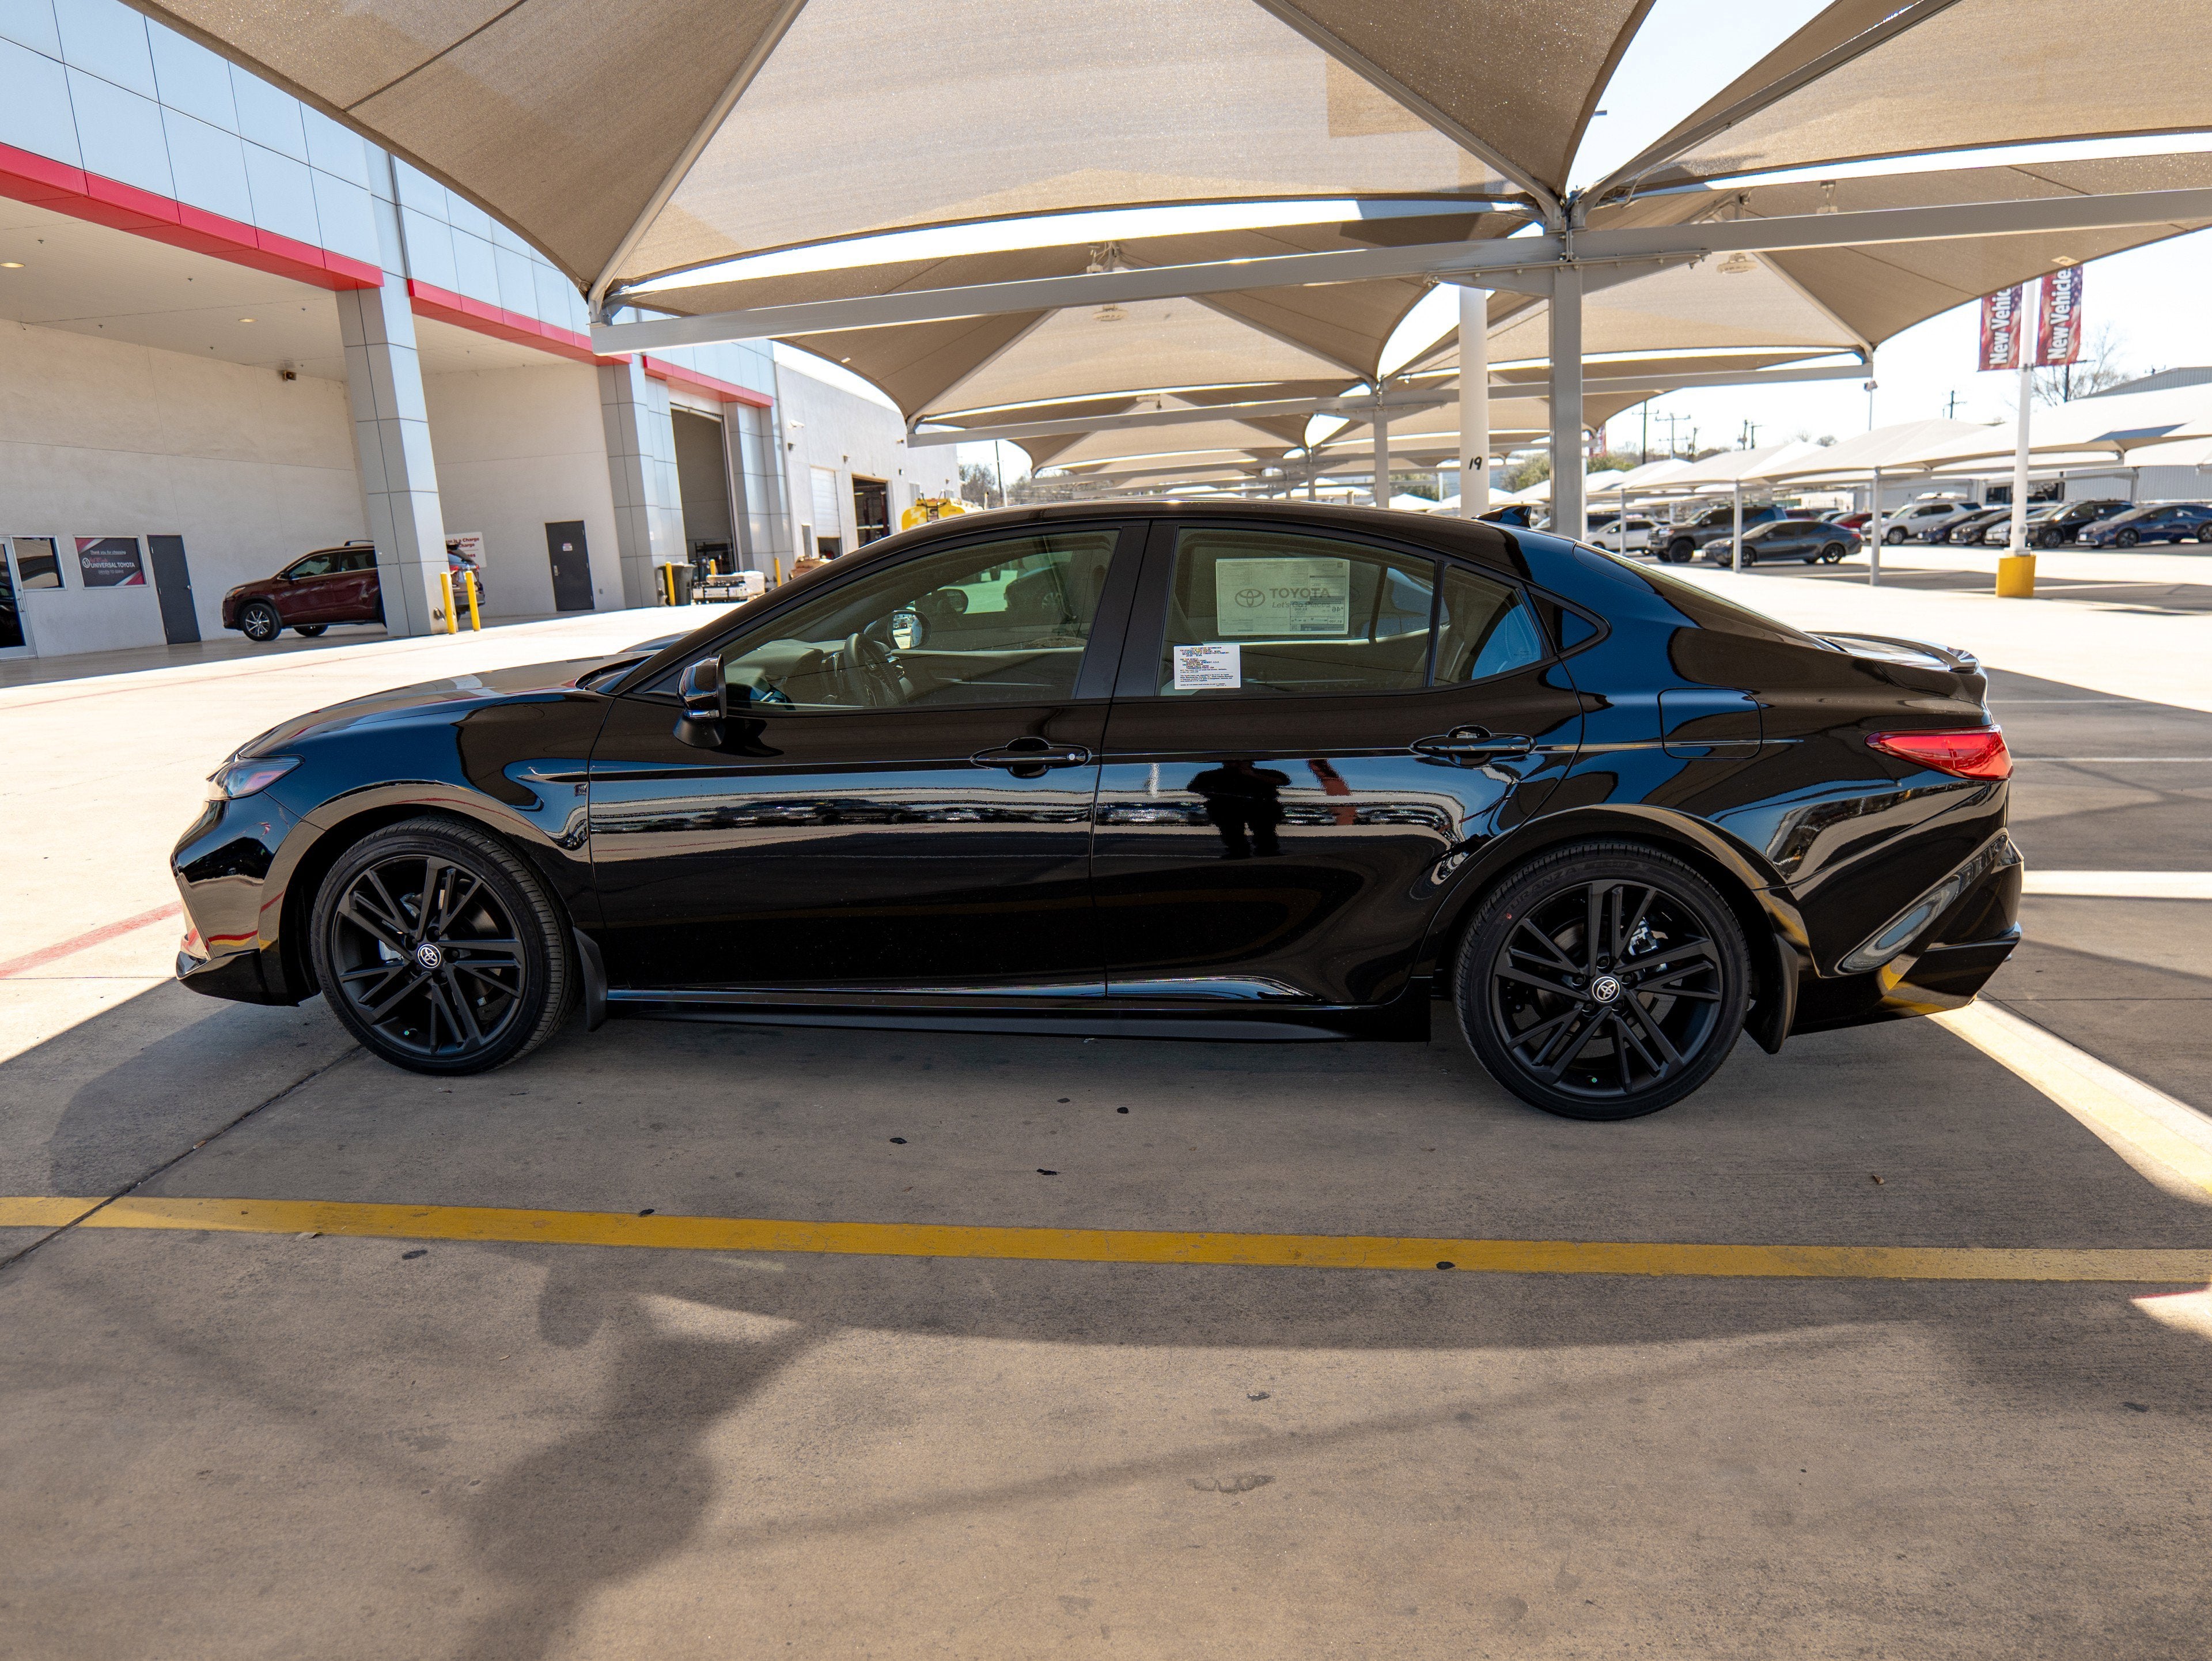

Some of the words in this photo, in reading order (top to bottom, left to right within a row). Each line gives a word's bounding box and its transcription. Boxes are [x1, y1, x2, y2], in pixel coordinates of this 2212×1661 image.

[1991, 287, 2012, 331] Vehic
[2049, 268, 2071, 325] Vehicle
[1988, 332, 2009, 364] New
[2047, 327, 2068, 360] New
[1468, 456, 1482, 470] 19
[1269, 588, 1331, 599] TOYOTA
